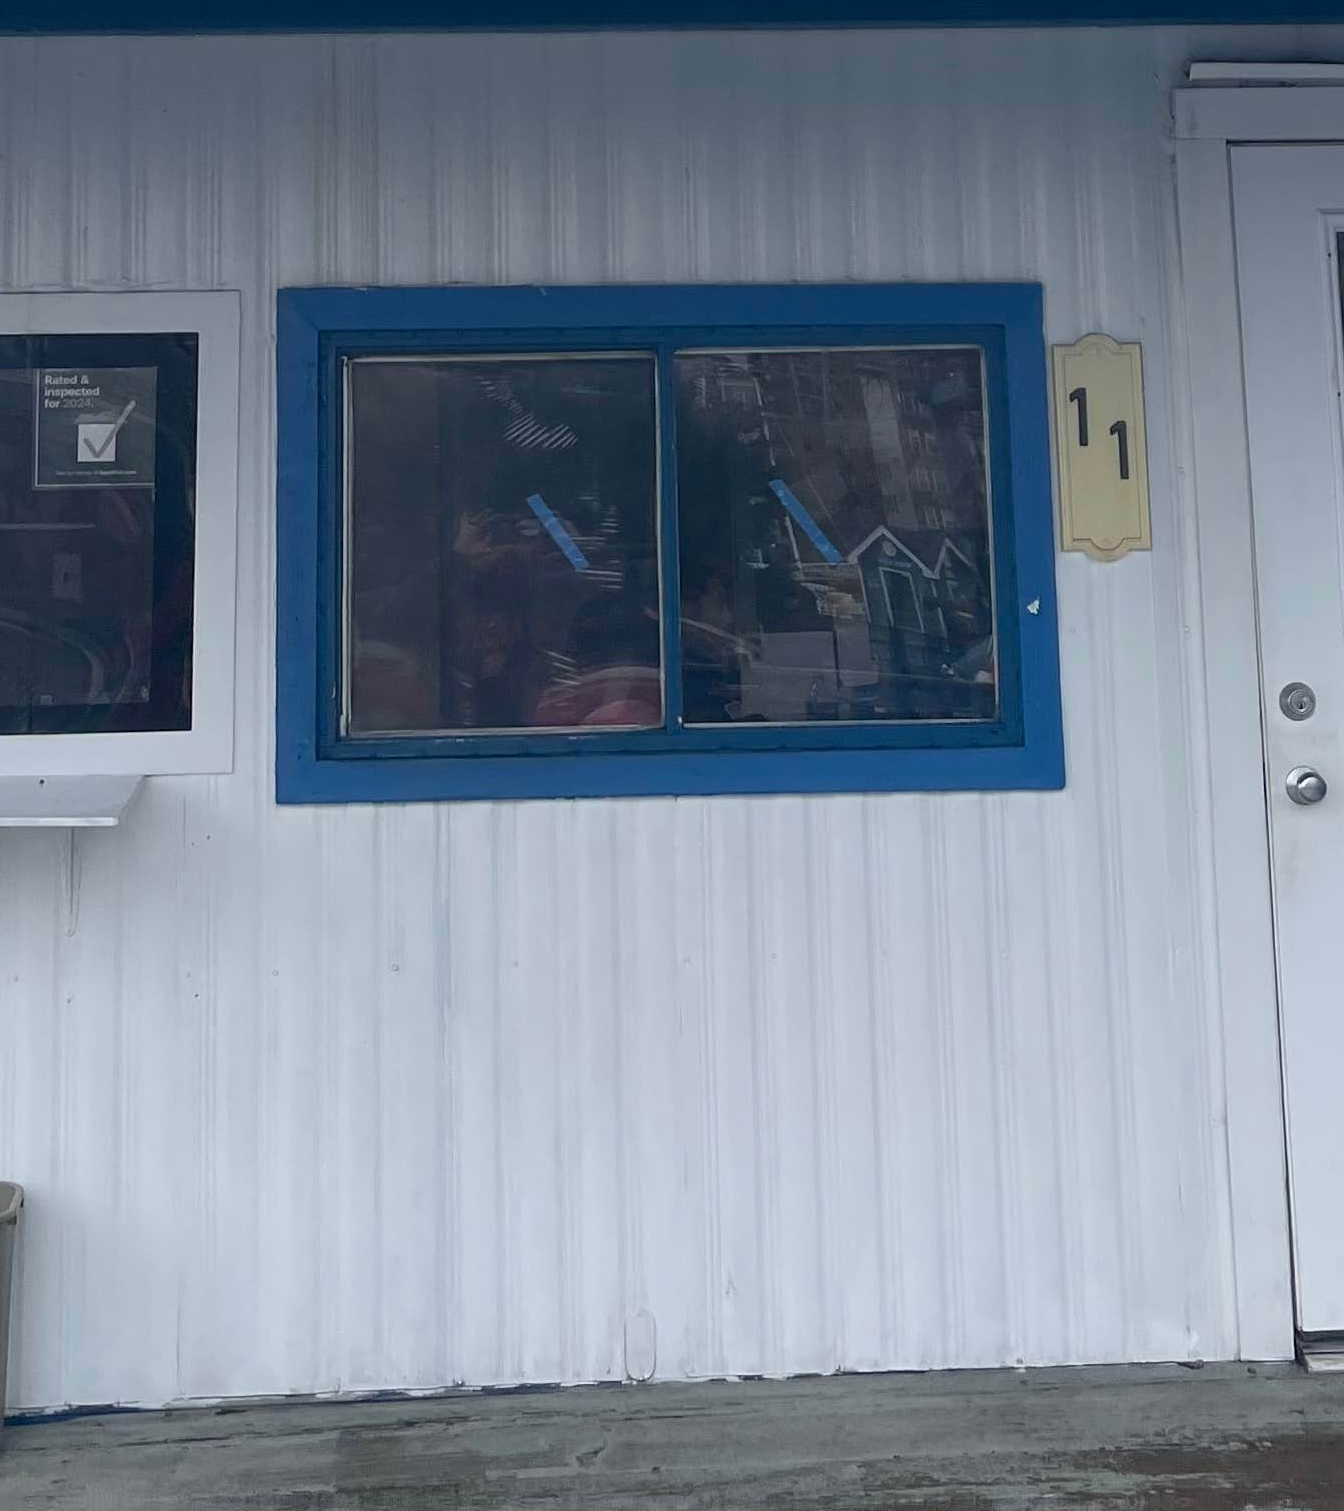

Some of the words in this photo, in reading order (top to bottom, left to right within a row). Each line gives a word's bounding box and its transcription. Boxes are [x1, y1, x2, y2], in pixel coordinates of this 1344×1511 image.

[45, 375, 78, 385] Rated
[81, 375, 89, 385] &
[44, 387, 100, 398] inspected
[44, 397, 60, 408] for
